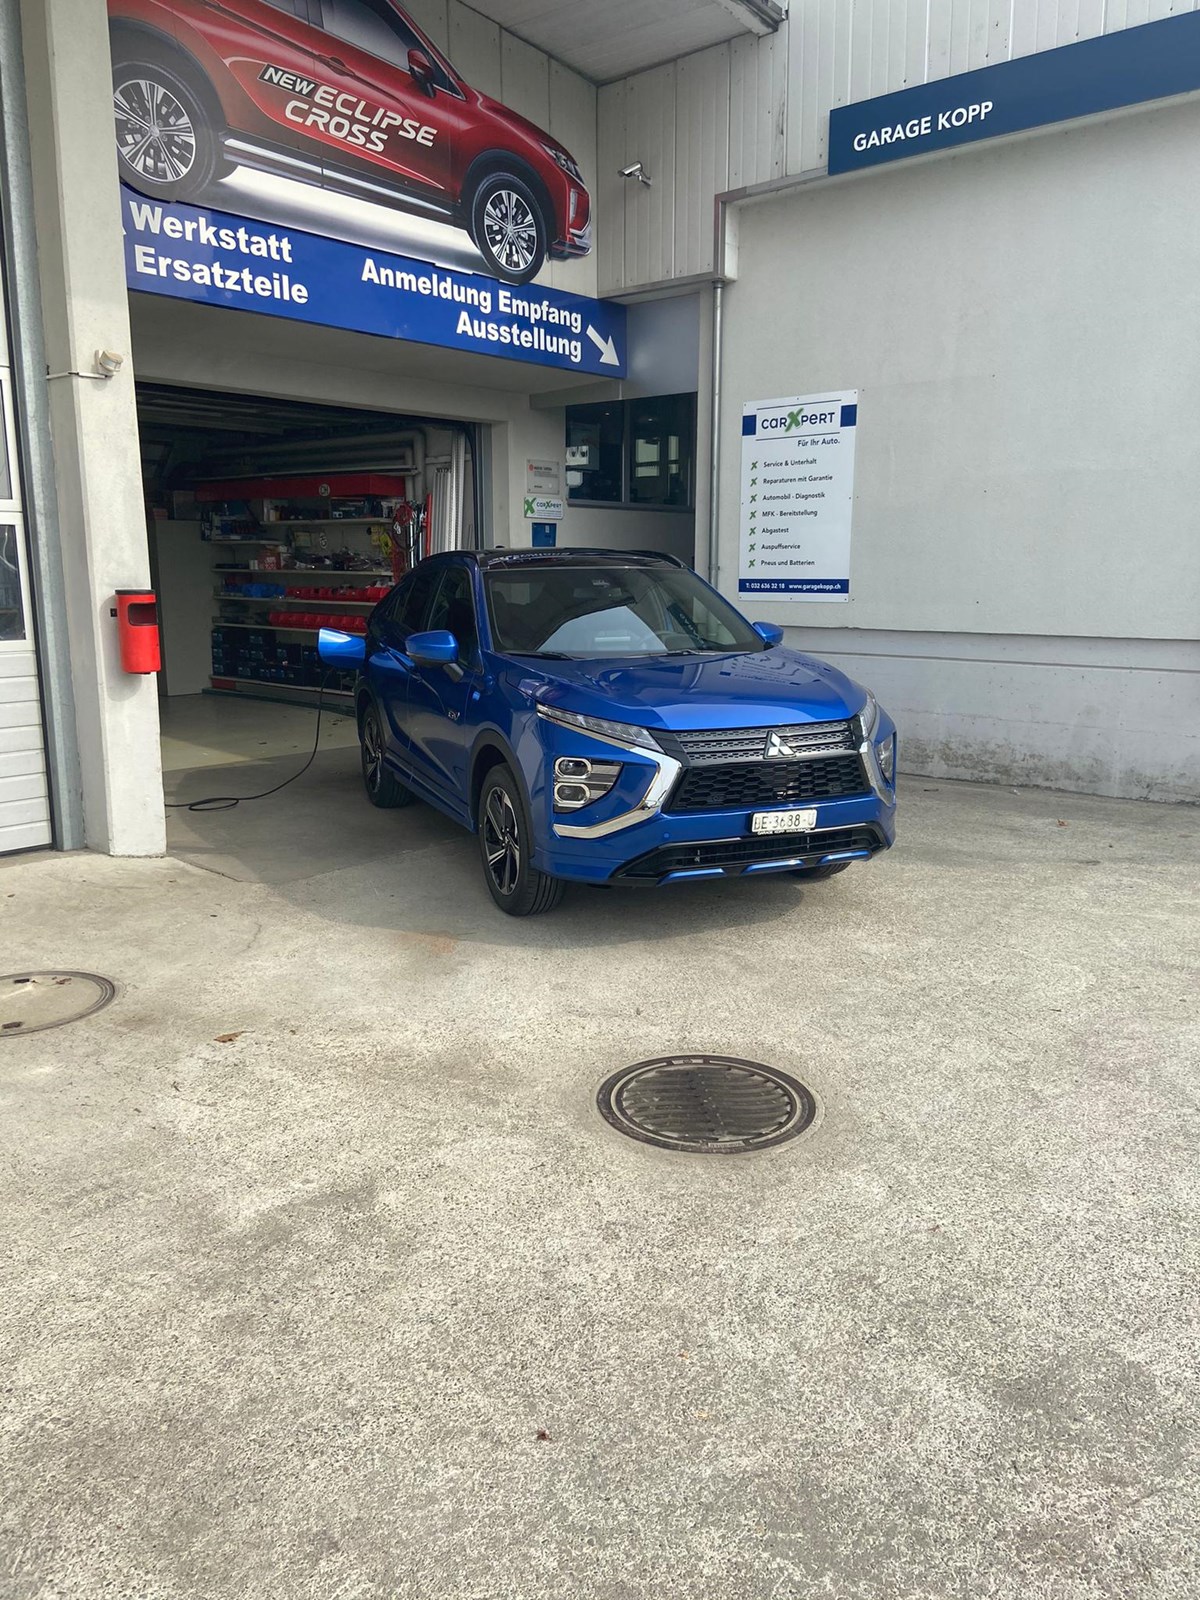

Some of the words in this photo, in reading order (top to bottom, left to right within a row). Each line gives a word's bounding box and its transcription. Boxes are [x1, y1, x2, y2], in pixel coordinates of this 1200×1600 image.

[263, 66, 316, 99] NEW
[314, 85, 438, 148] ECLIPSE
[285, 100, 389, 153] CROSS
[853, 116, 932, 152] GARAGE
[937, 101, 993, 131] KOPP
[130, 201, 293, 264] Werkstatt
[134, 245, 309, 305] Ersatzteile
[361, 257, 493, 314] Anmeldung
[498, 290, 582, 333] Empfang
[456, 311, 582, 363] Ausstellung
[763, 477, 796, 485] Reparaturen
[808, 474, 833, 482] Garantie
[790, 458, 817, 466] Unterhalt
[762, 493, 791, 501] Automobil
[795, 492, 825, 500] Diagnostik
[779, 509, 818, 518] Bereitstellung
[761, 543, 801, 551] Auspuffservice
[762, 527, 789, 535] Abgastest
